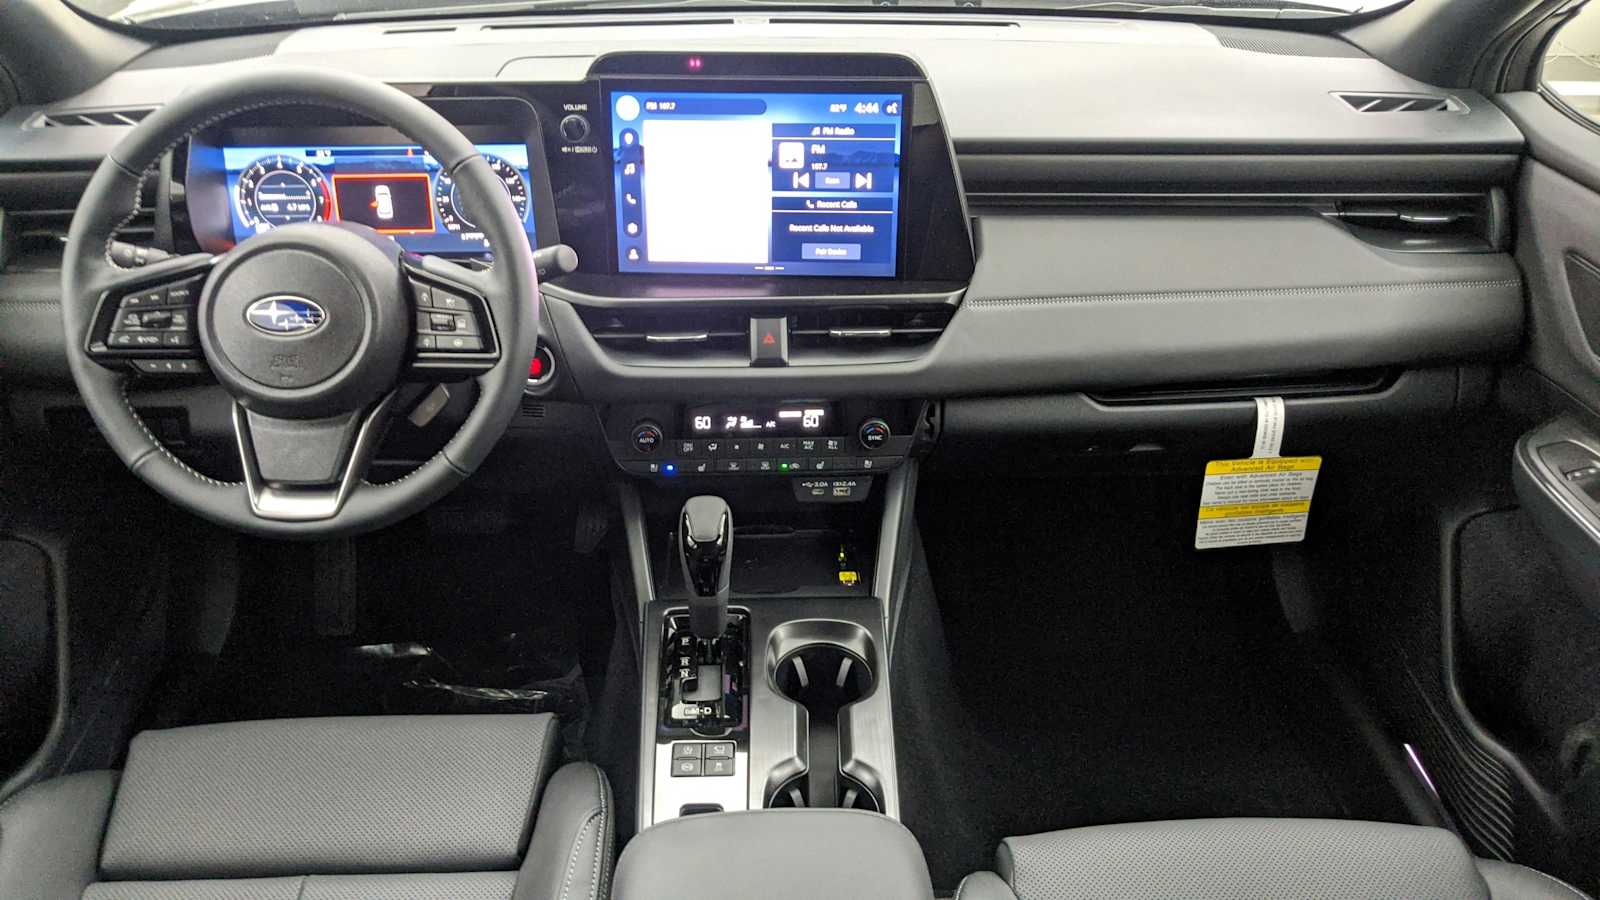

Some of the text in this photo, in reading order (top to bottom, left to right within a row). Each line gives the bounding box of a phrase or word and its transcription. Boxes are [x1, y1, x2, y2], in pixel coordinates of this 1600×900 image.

[854, 102, 879, 113] 4:44
[835, 127, 855, 135] Radio
[811, 144, 826, 154] FM
[789, 224, 813, 232] Recent
[814, 224, 829, 232] Calls
[844, 225, 874, 233] Available
[695, 416, 711, 429] 60
[803, 414, 819, 427] 60
